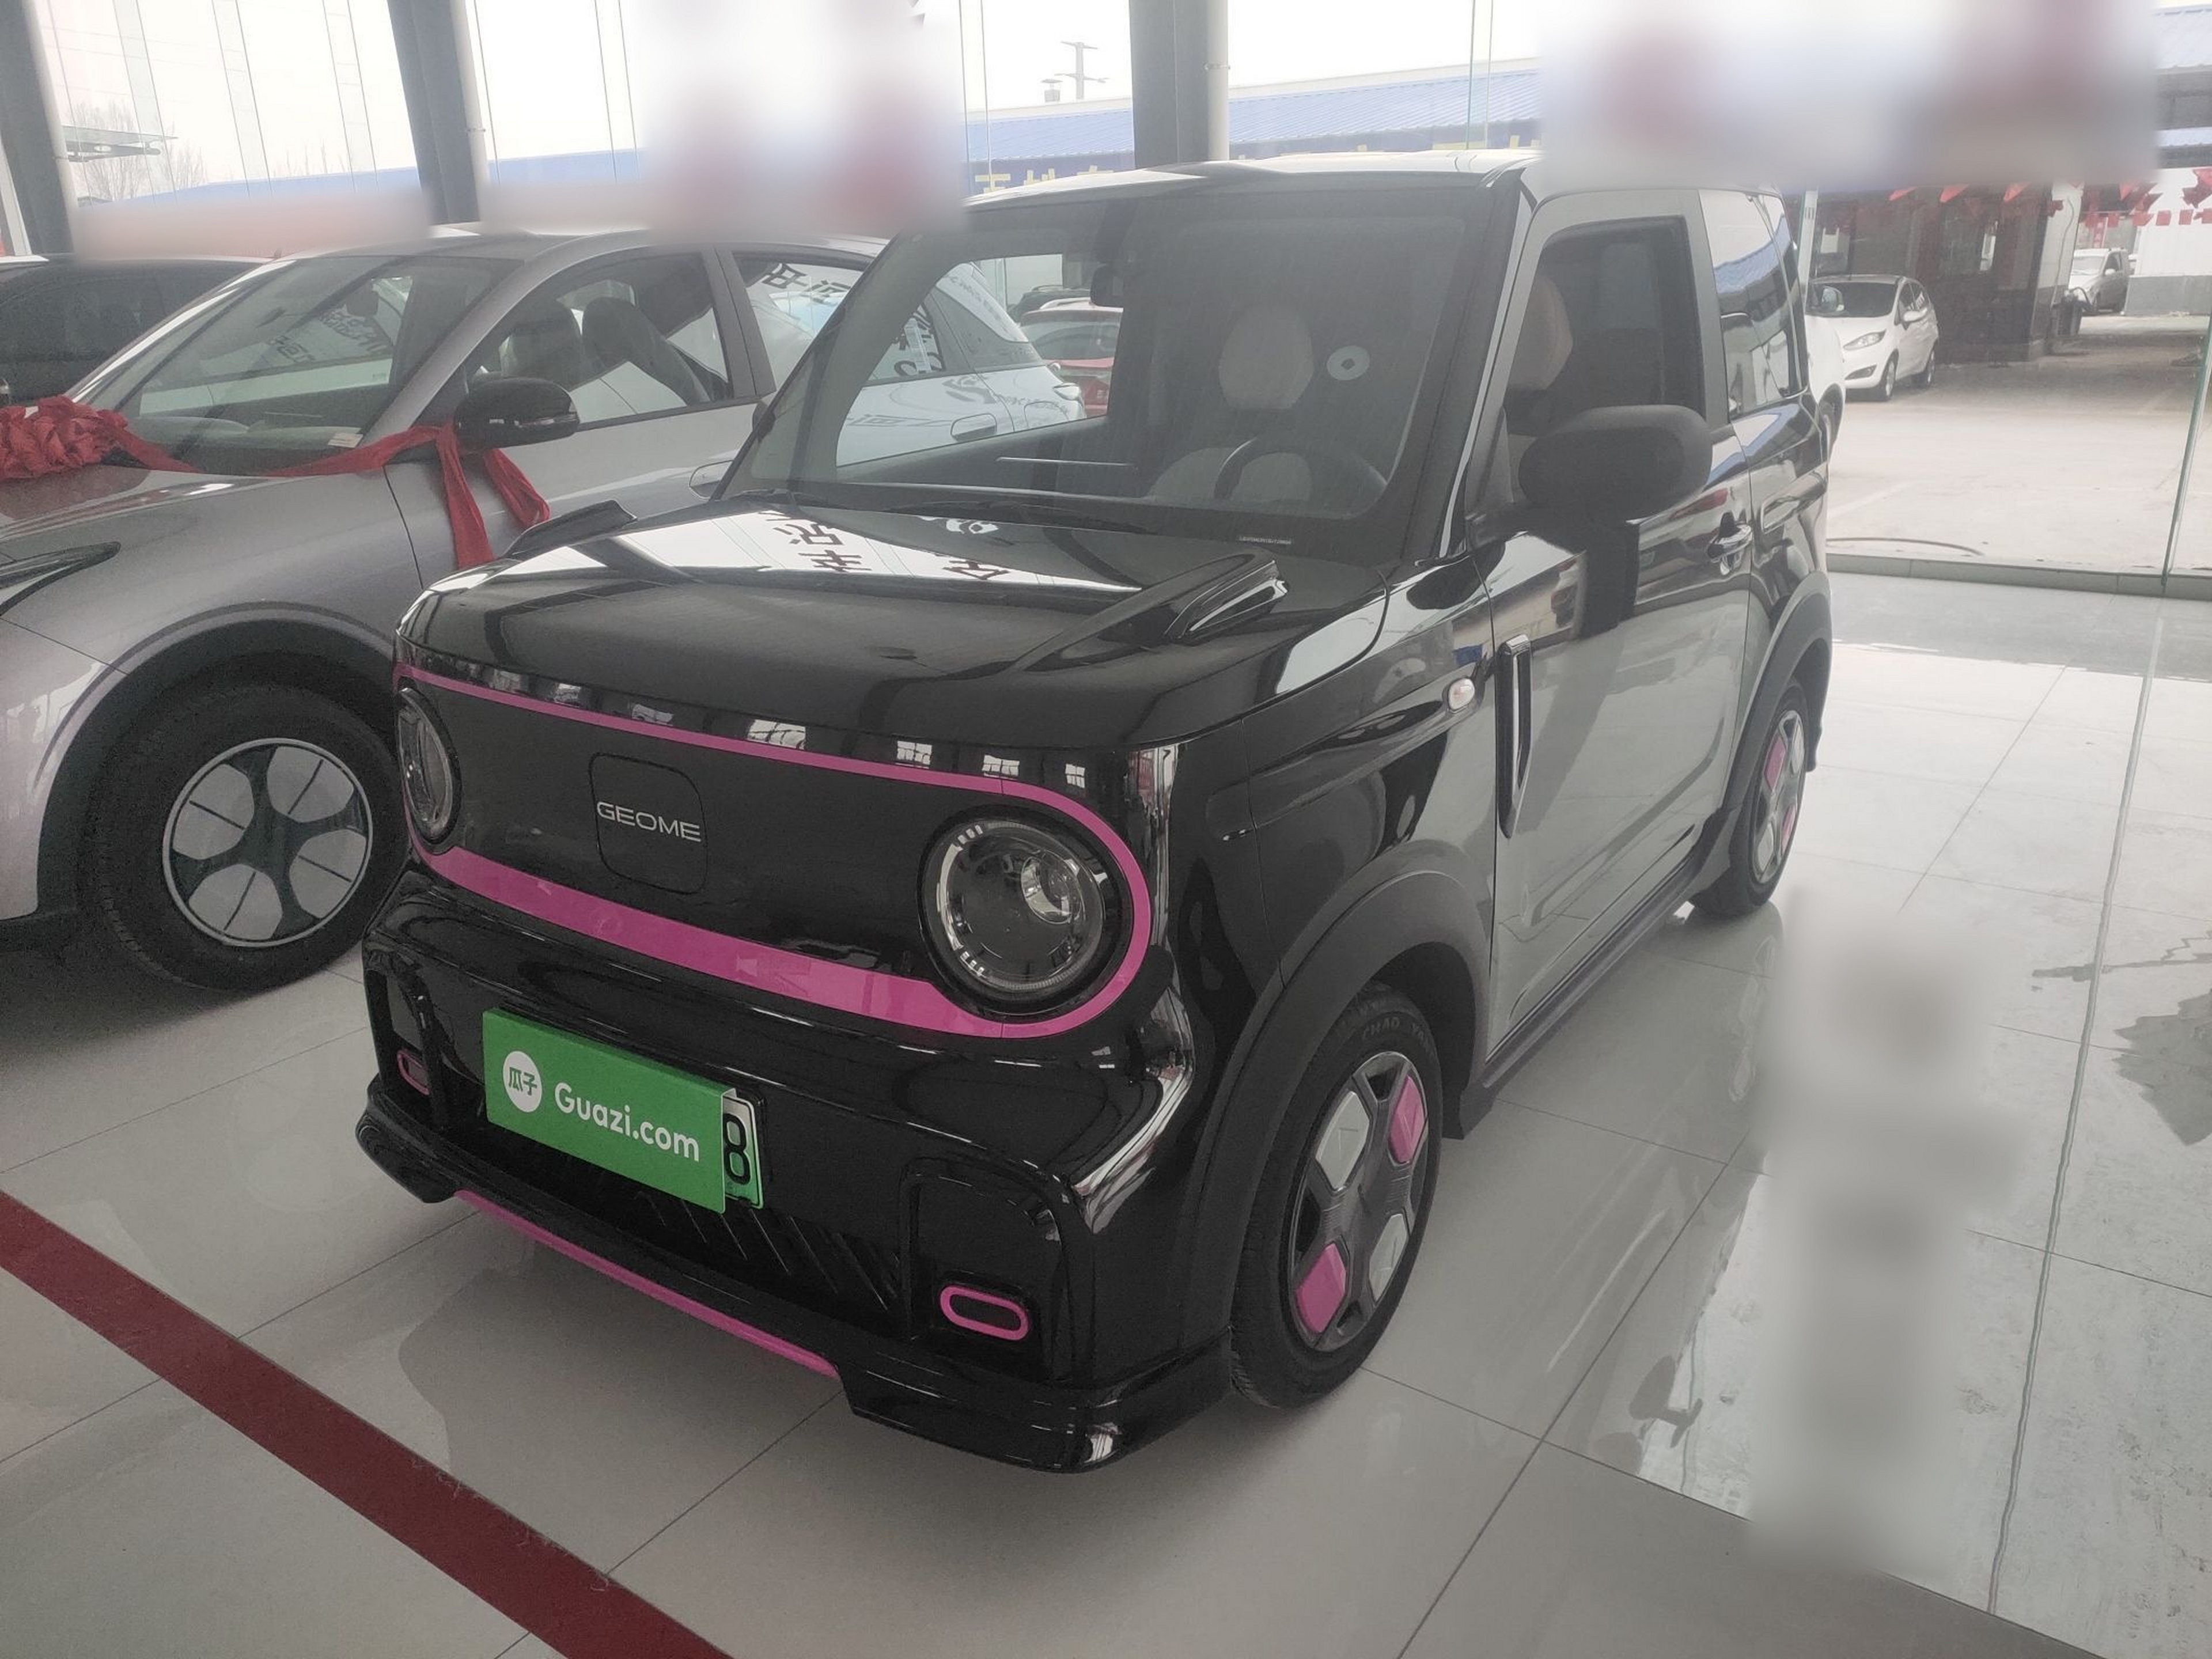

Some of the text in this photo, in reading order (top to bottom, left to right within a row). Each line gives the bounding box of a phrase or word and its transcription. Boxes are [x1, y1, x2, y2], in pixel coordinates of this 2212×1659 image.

[597, 801, 702, 842] GEOME
[508, 1066, 538, 1097] 瓜子
[554, 1082, 700, 1162] Guazi.com
